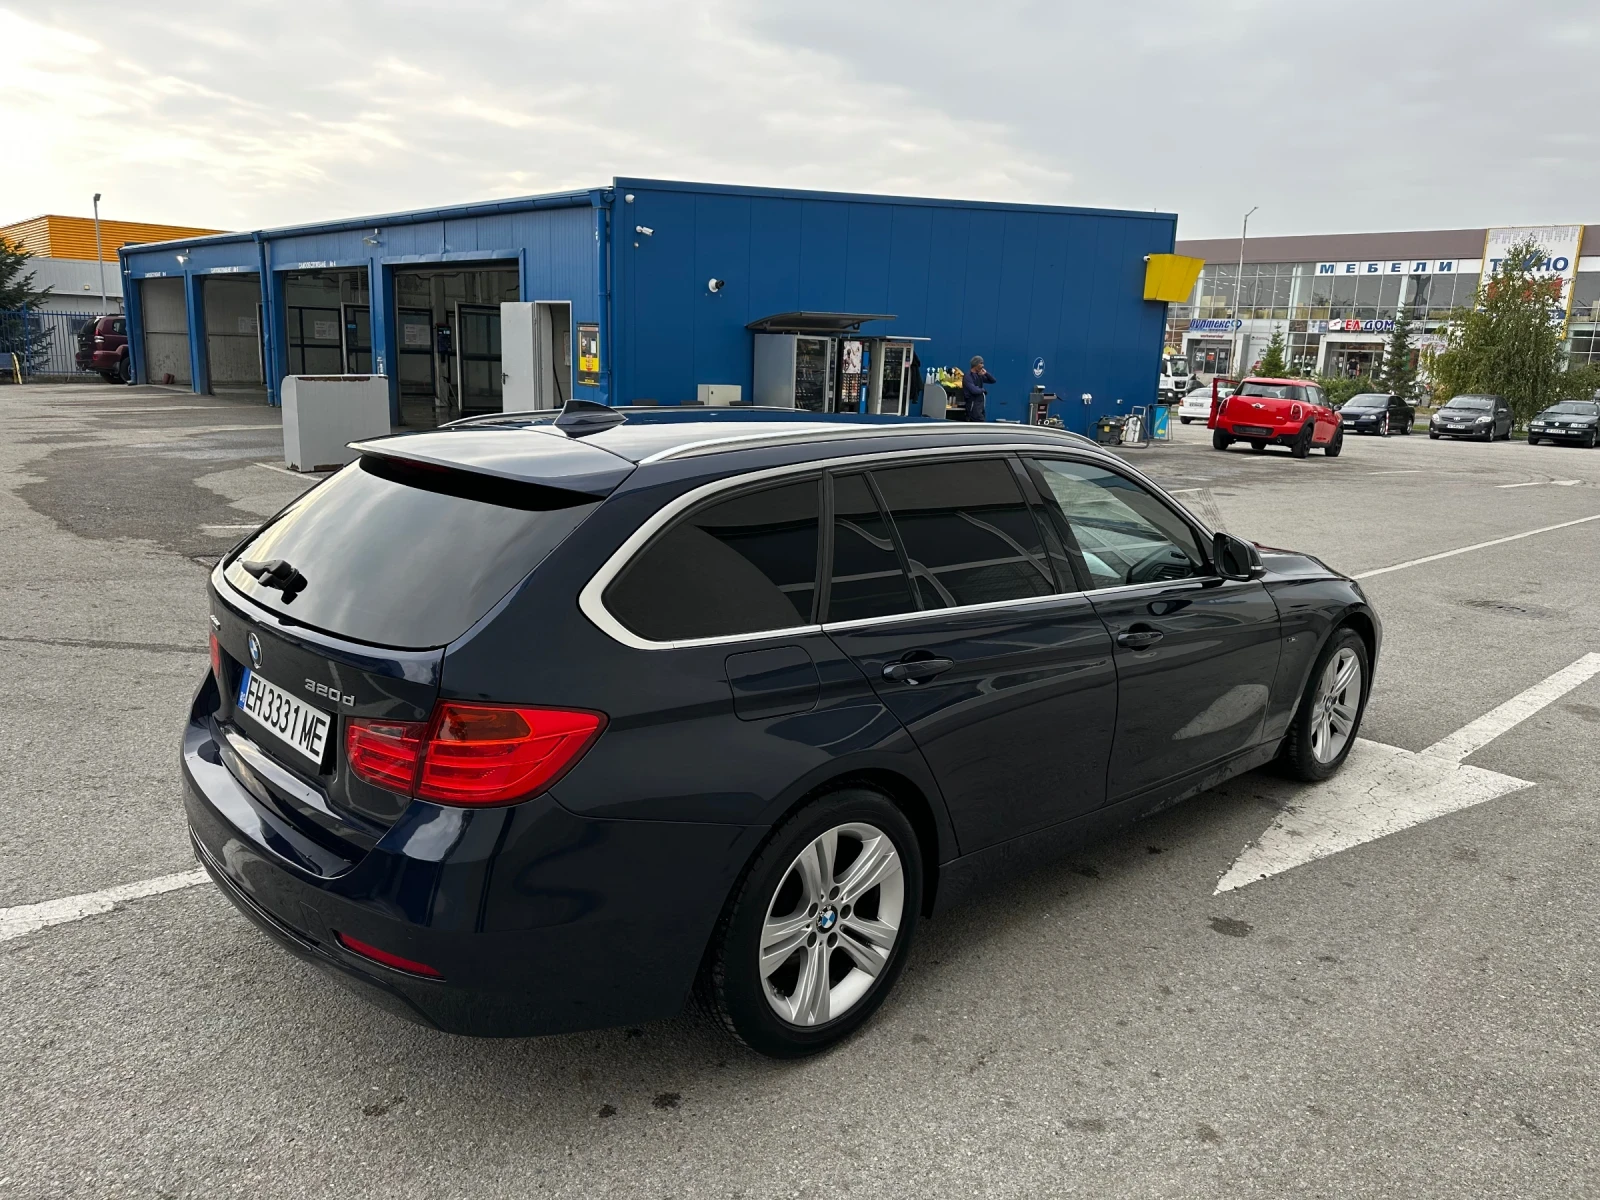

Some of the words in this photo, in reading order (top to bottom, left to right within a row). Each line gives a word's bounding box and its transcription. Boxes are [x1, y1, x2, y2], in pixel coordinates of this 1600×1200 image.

[1319, 261, 1453, 274] МЕБЕЛИ
[1345, 320, 1360, 330] ЕЛ
[1364, 320, 1395, 330] ДОМ
[304, 678, 355, 707] 320d
[245, 675, 267, 717] EH
[263, 688, 300, 741] 3331
[299, 710, 327, 758] ME
